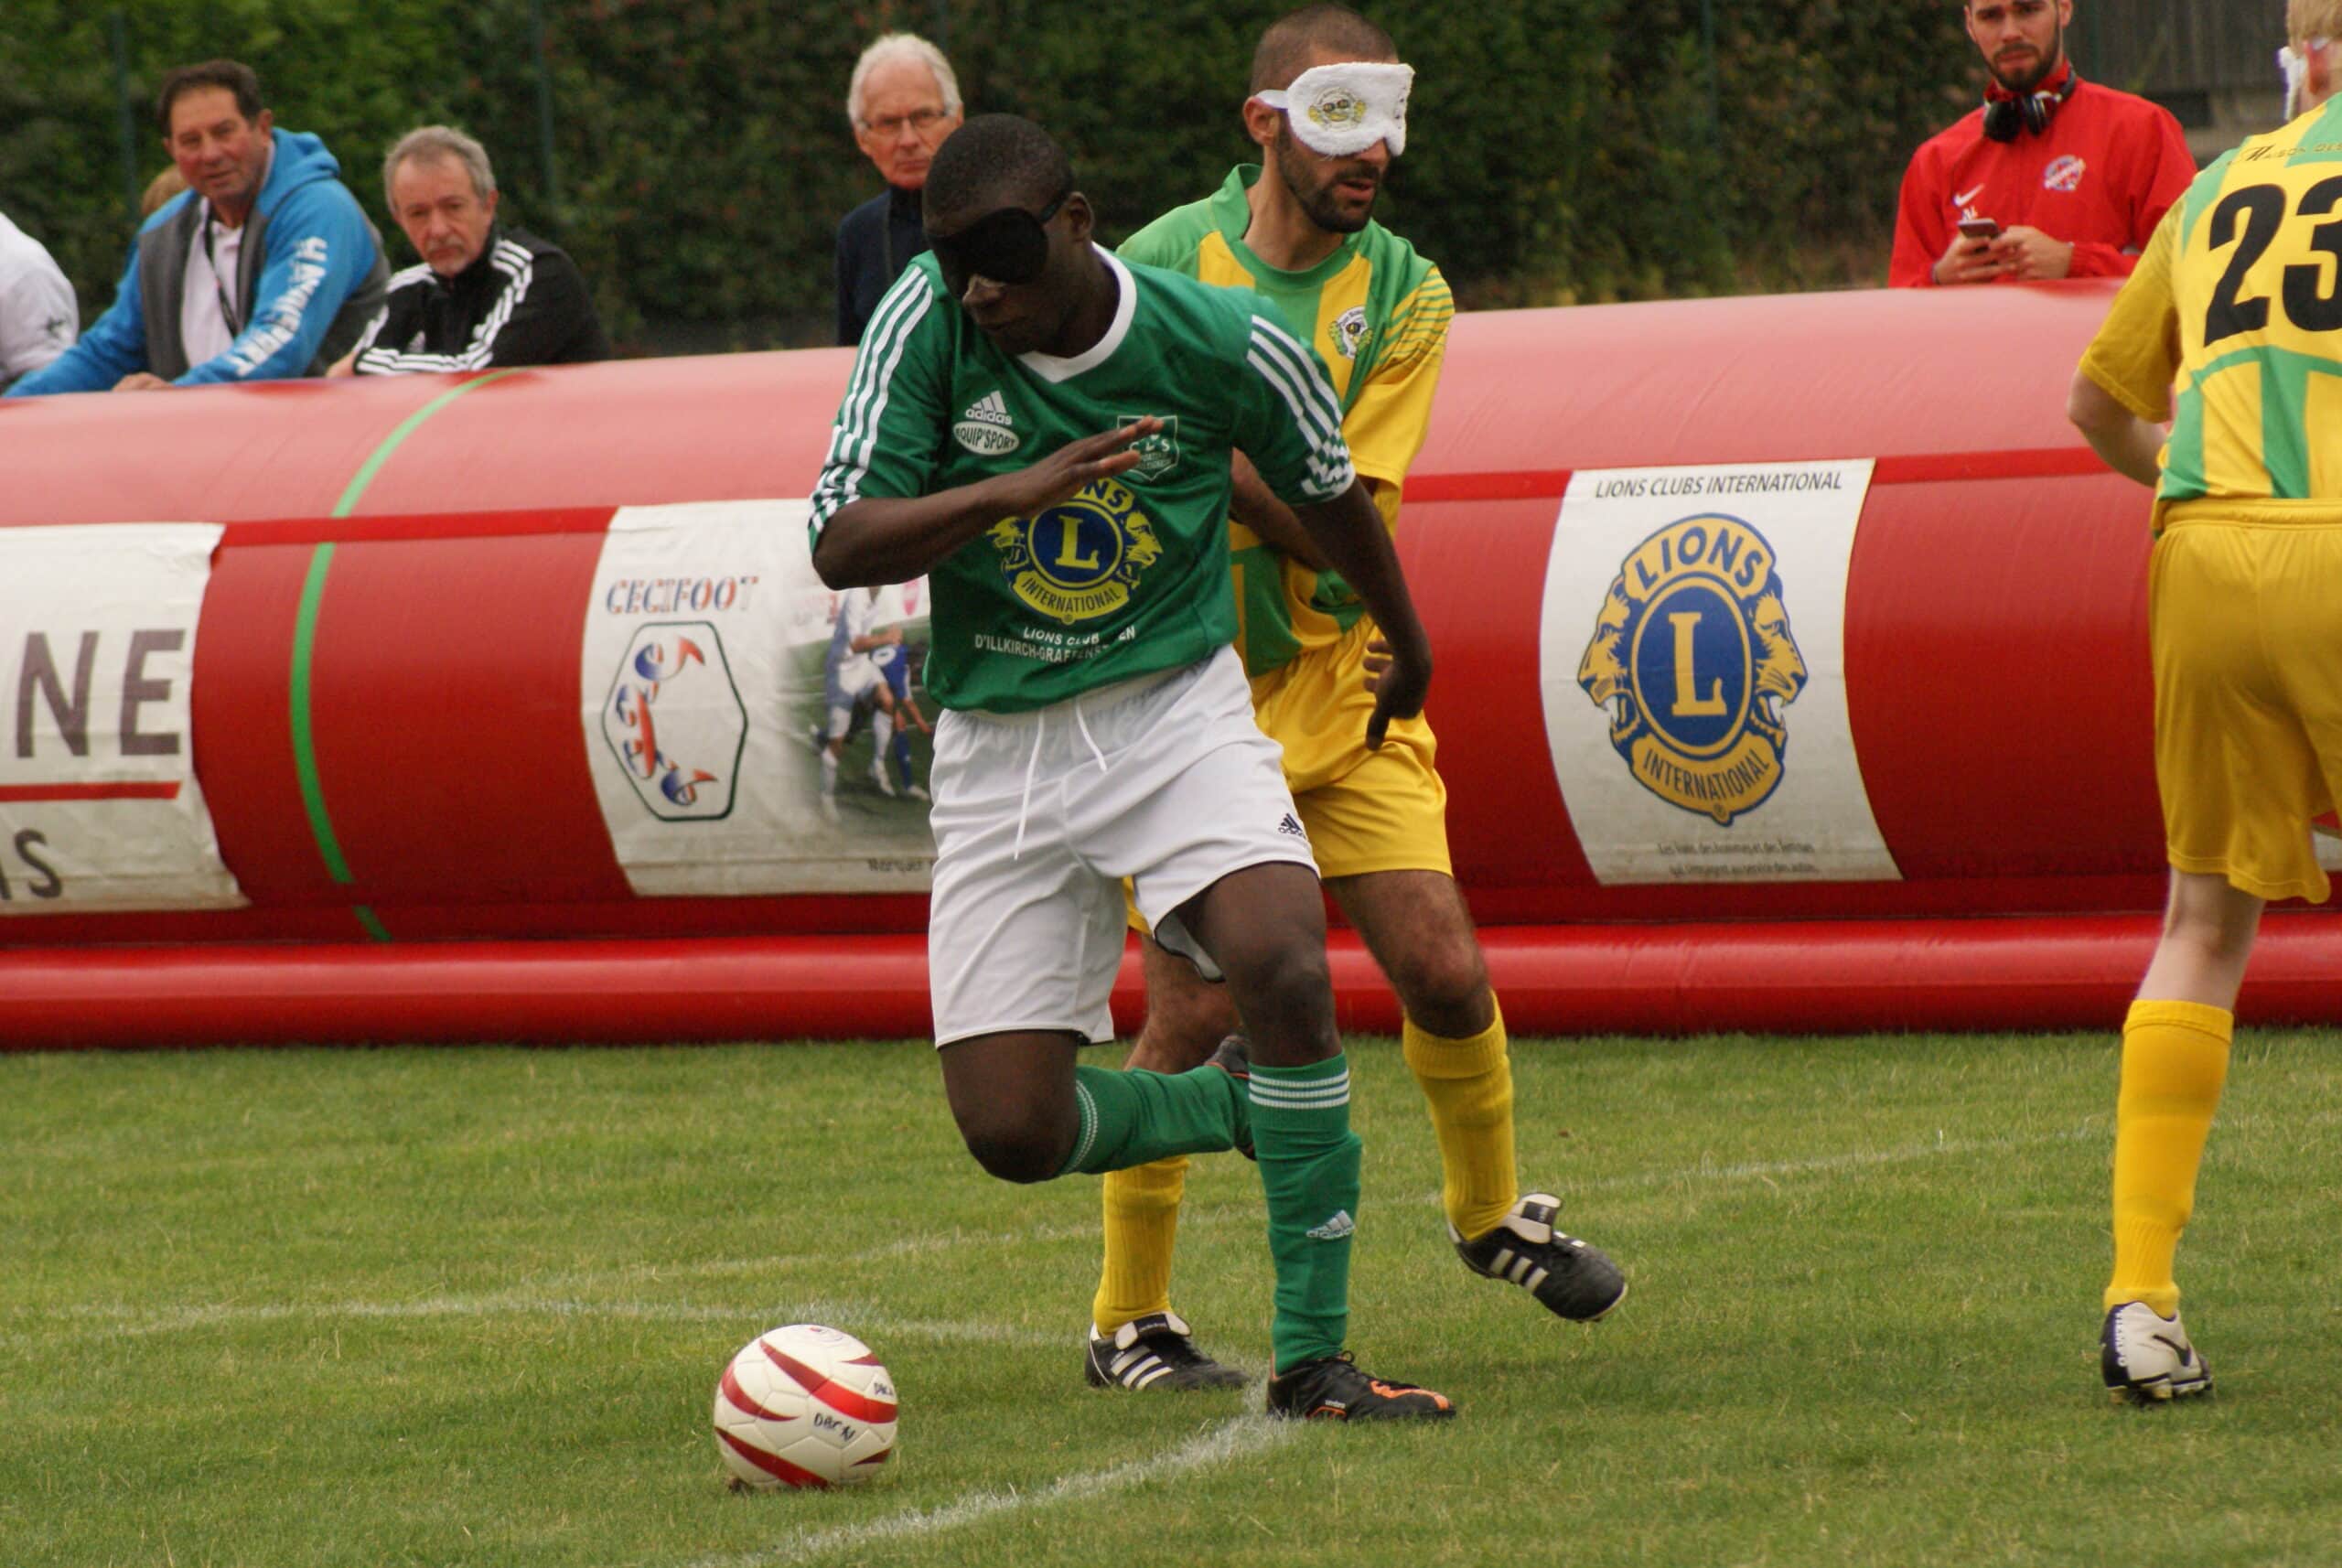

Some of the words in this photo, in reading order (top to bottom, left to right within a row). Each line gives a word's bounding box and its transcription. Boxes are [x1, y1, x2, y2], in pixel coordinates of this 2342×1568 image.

[2204, 175, 2342, 349] 23
[965, 408, 1013, 425] adidas
[1595, 478, 1646, 499] LIONS
[1650, 476, 1704, 496] CLUBS
[1706, 472, 1843, 494] INTERNATIONAL
[1055, 513, 1101, 570] L
[1635, 525, 1764, 592] LIONS
[606, 576, 759, 615] CECIFOOT
[1021, 577, 1121, 613] INTERNATIONAL
[1024, 627, 1063, 645] LIONS
[1067, 632, 1100, 646] CLUB
[1668, 610, 1727, 717] L
[16, 628, 186, 758] NE
[1643, 747, 1770, 801] INTERNATIONAL
